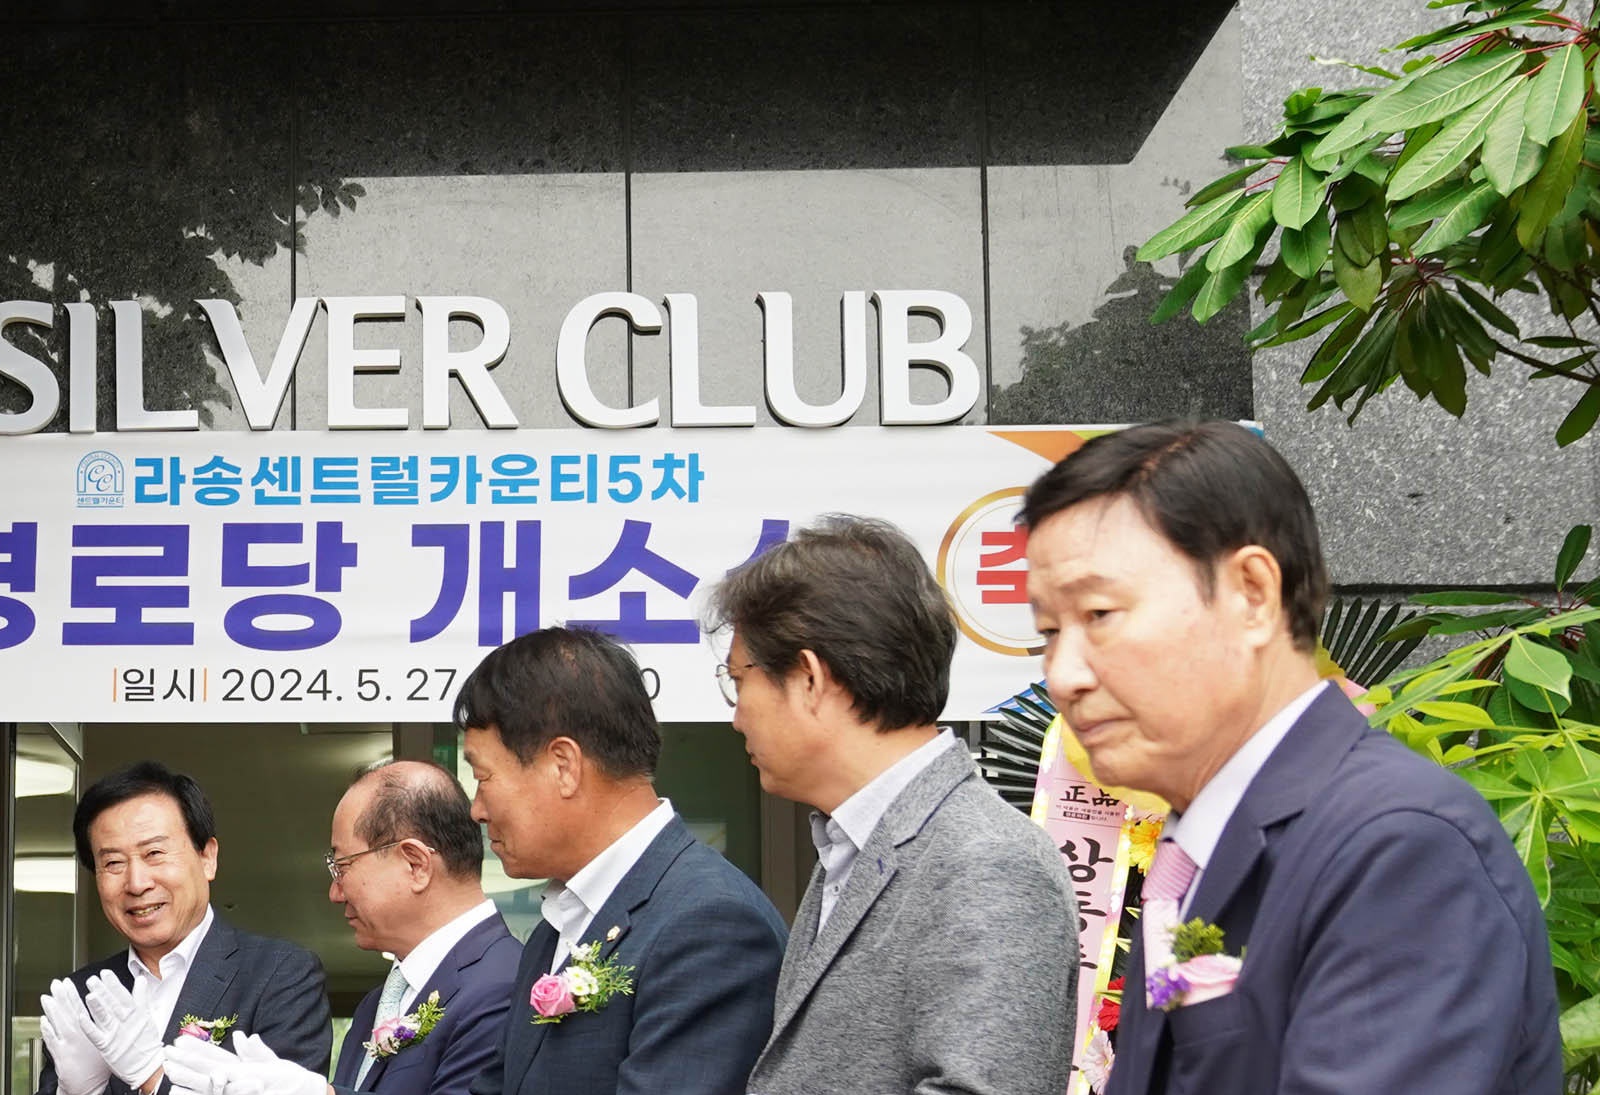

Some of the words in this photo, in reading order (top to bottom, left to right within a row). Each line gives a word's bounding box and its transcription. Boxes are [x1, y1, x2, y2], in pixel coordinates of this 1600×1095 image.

[556, 289, 984, 428] CLUB
[134, 453, 706, 506] 라송센트럴카운티5차
[409, 518, 791, 646] 개소
[122, 668, 196, 702] 일시
[221, 668, 343, 702] 2024.
[356, 668, 392, 702] 5.
